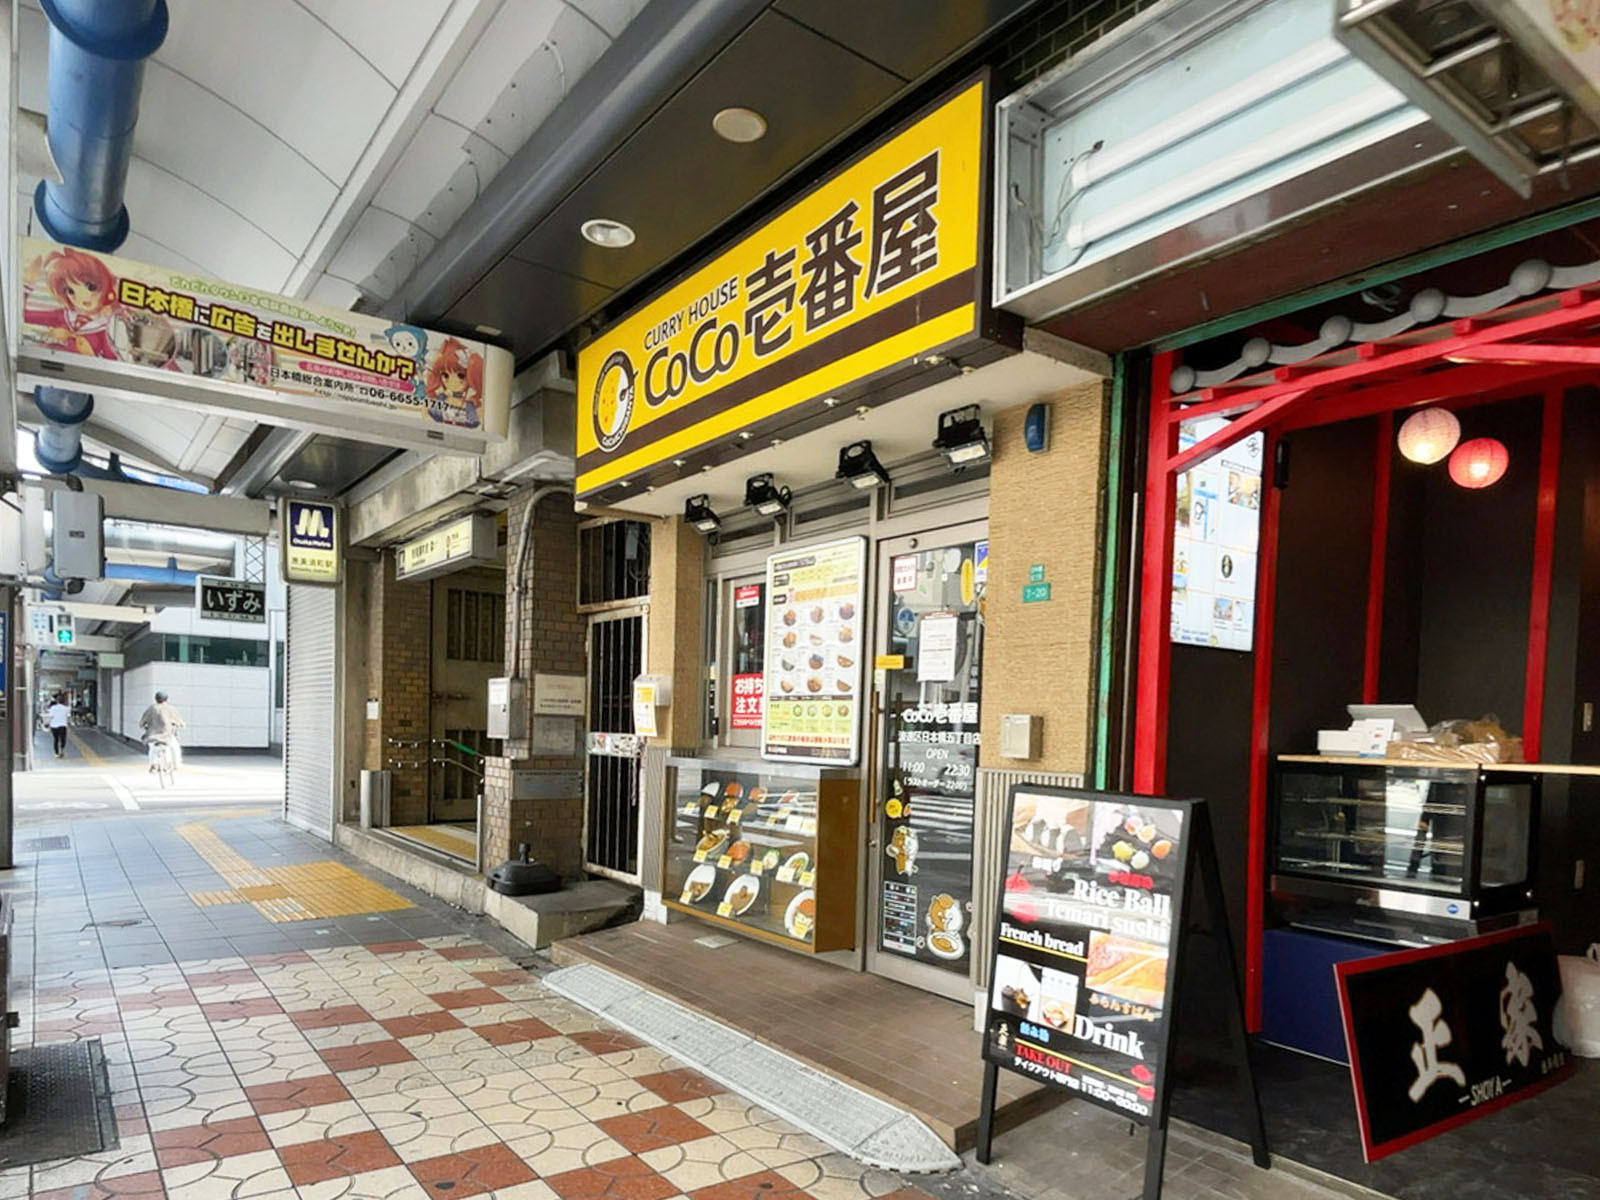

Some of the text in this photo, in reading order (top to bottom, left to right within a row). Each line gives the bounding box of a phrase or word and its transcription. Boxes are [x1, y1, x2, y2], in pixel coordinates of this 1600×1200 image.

[119, 278, 415, 379] 日本橋に広告を出しませんか?
[643, 275, 739, 351] CURRY HOUSE
[207, 589, 262, 613] いずみ
[902, 761, 925, 773] 11:00
[944, 763, 971, 777] 22:30
[926, 748, 949, 759] OPEN
[1072, 879, 1171, 918] Rice Ball
[1001, 922, 1084, 957] French bread
[1113, 916, 1170, 943] sushi
[1074, 1014, 1145, 1060] Drink
[1015, 1042, 1073, 1075] TAKE OUT
